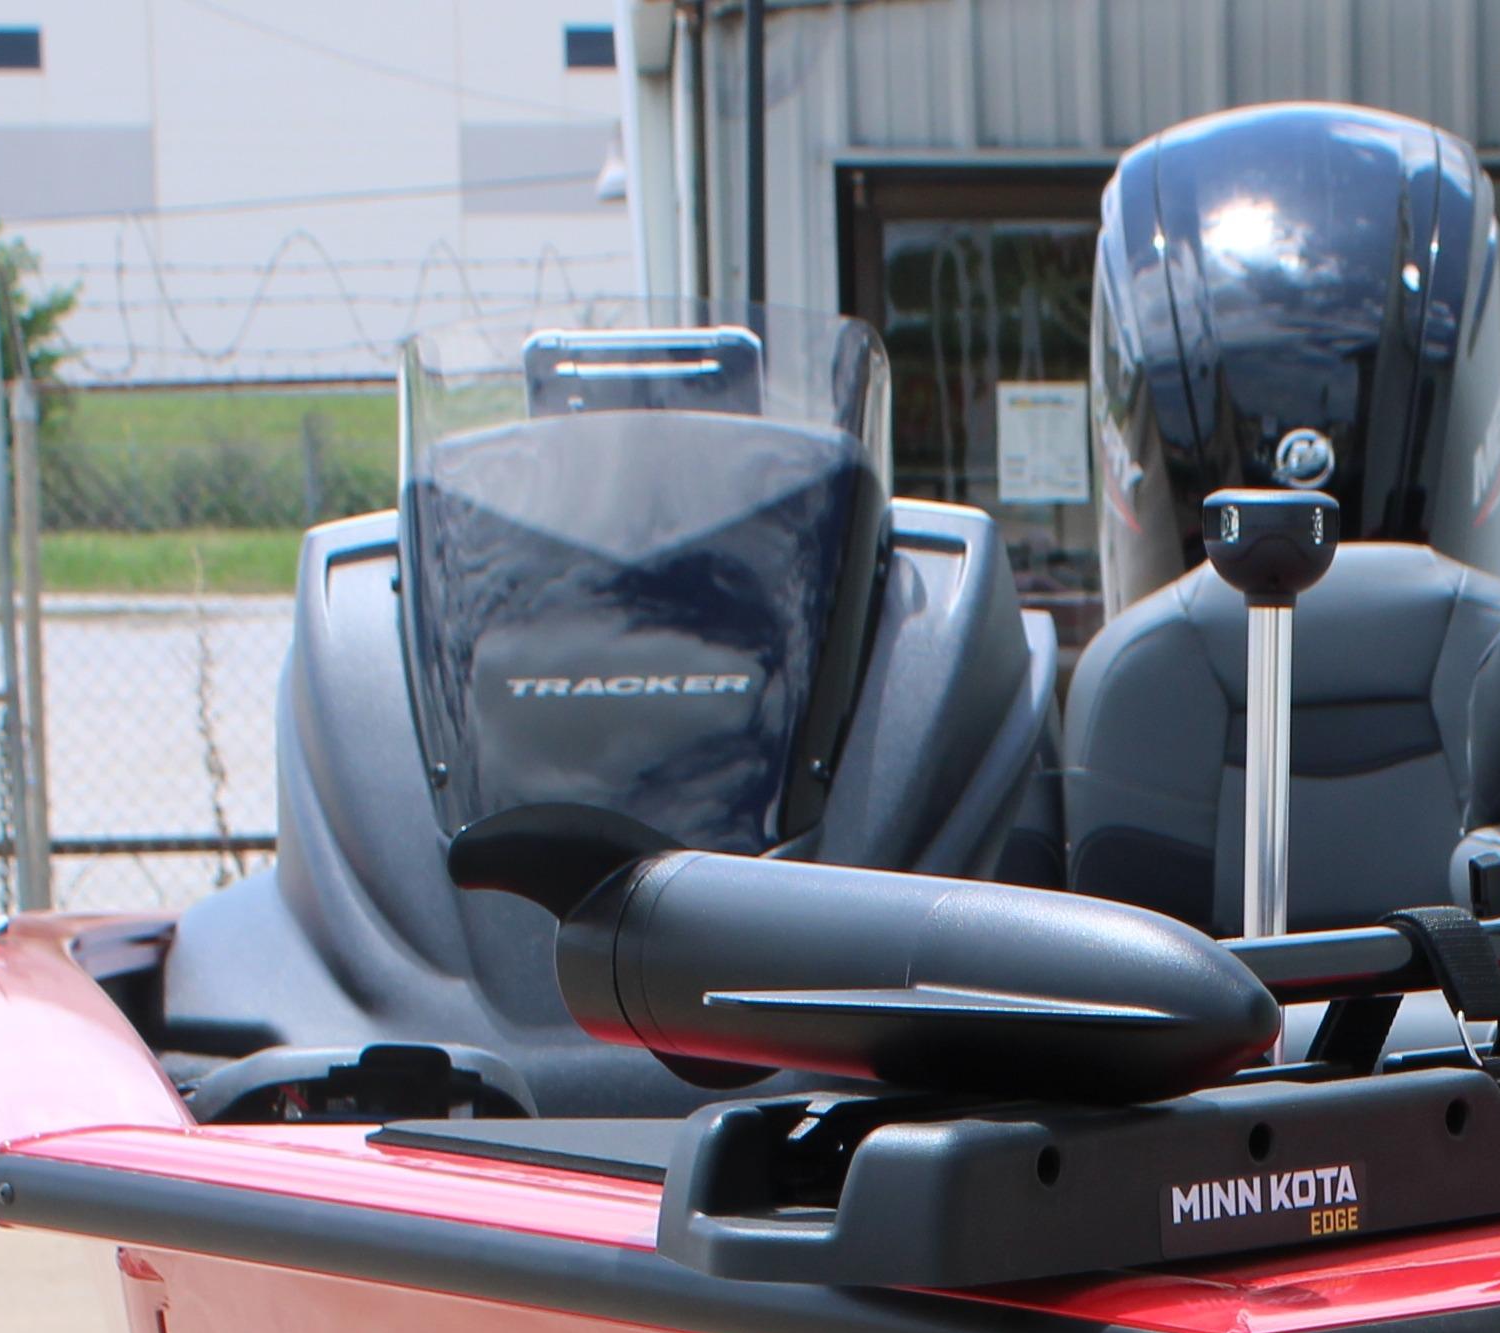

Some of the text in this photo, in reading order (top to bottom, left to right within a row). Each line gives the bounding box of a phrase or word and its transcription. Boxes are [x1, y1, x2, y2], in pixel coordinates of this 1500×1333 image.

[506, 674, 750, 698] TRACKER
[1172, 1165, 1358, 1224] MINN KOTA
[1311, 1207, 1359, 1235] EDGE
